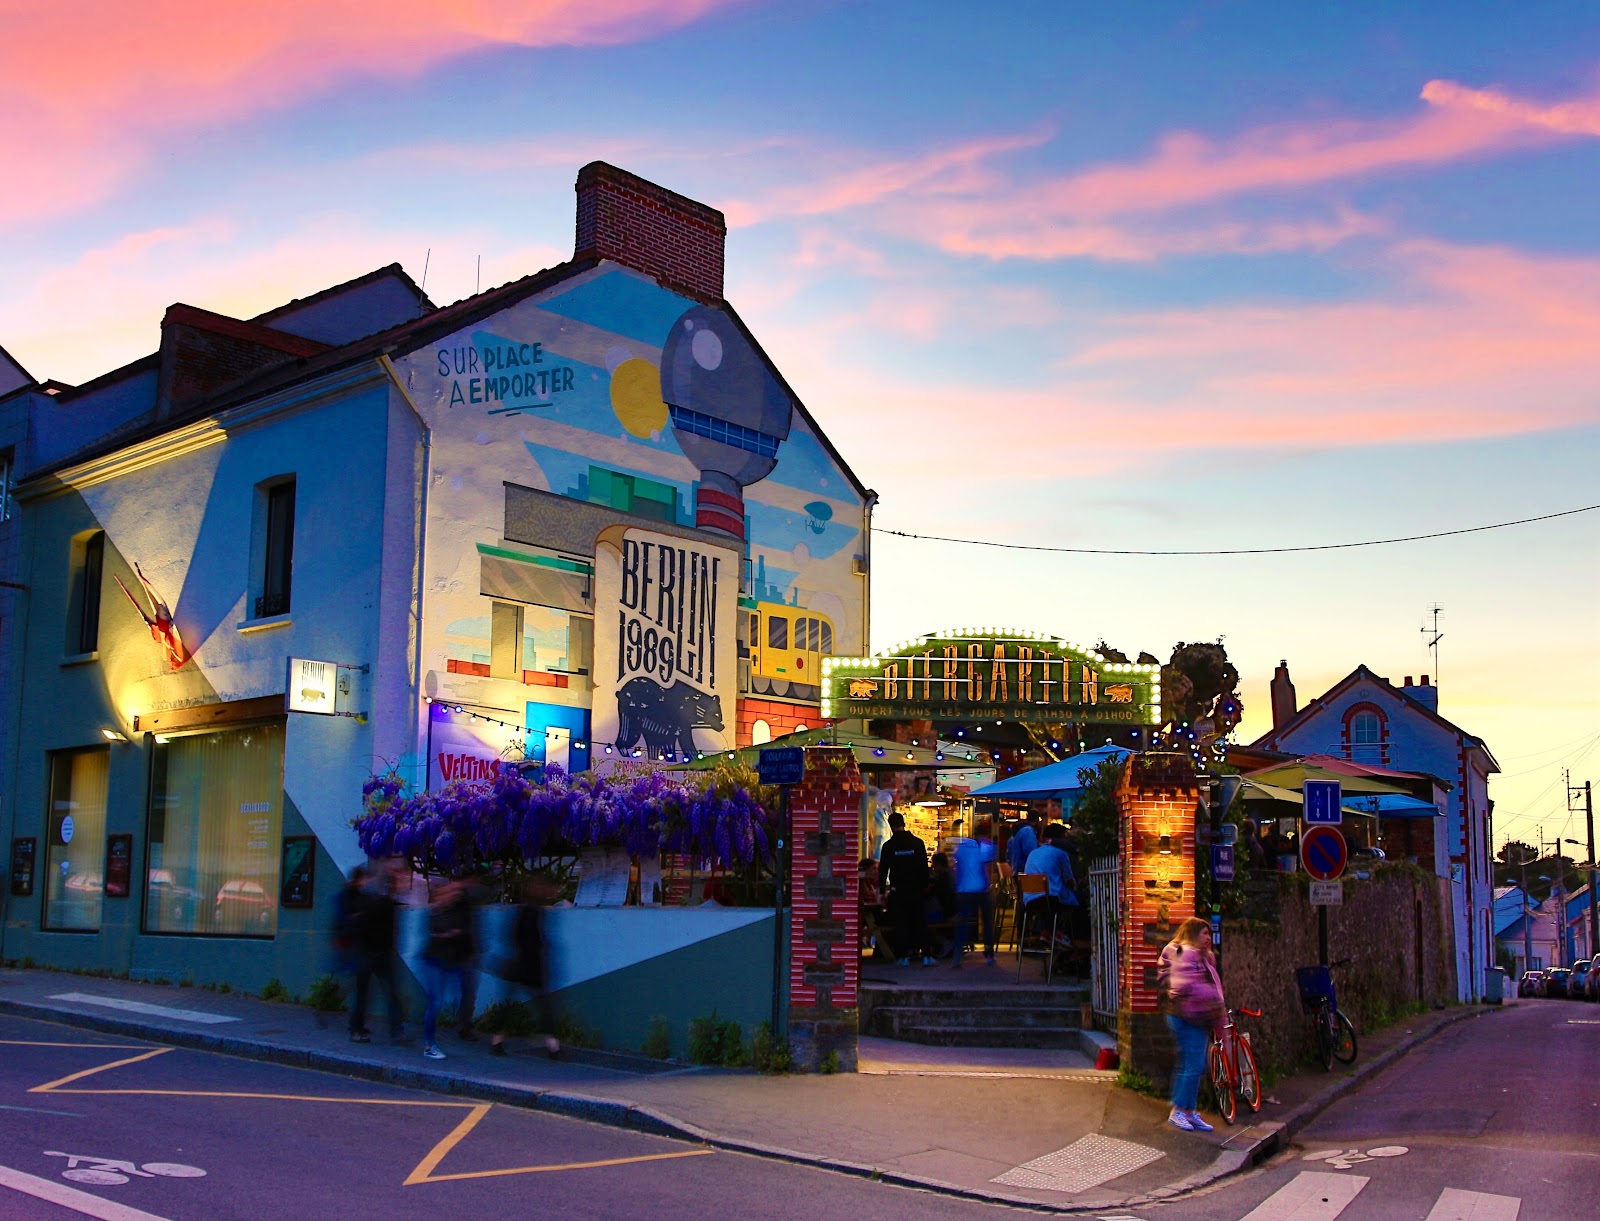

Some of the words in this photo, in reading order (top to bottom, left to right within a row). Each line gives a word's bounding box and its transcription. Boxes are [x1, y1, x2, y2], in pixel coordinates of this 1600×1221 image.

[437, 346, 479, 377] SUR
[484, 342, 544, 373] PLACE
[468, 366, 575, 404] EMPORTER
[618, 538, 721, 690] BERLIN
[616, 609, 675, 684] 1989
[882, 642, 1100, 704] BIERGARTEN
[849, 705, 894, 716] OUVERT
[902, 706, 932, 717] TOUS
[940, 708, 961, 718] LES
[969, 708, 1006, 719] JOURS
[1014, 708, 1029, 719] DE
[1096, 710, 1133, 721] 01H00
